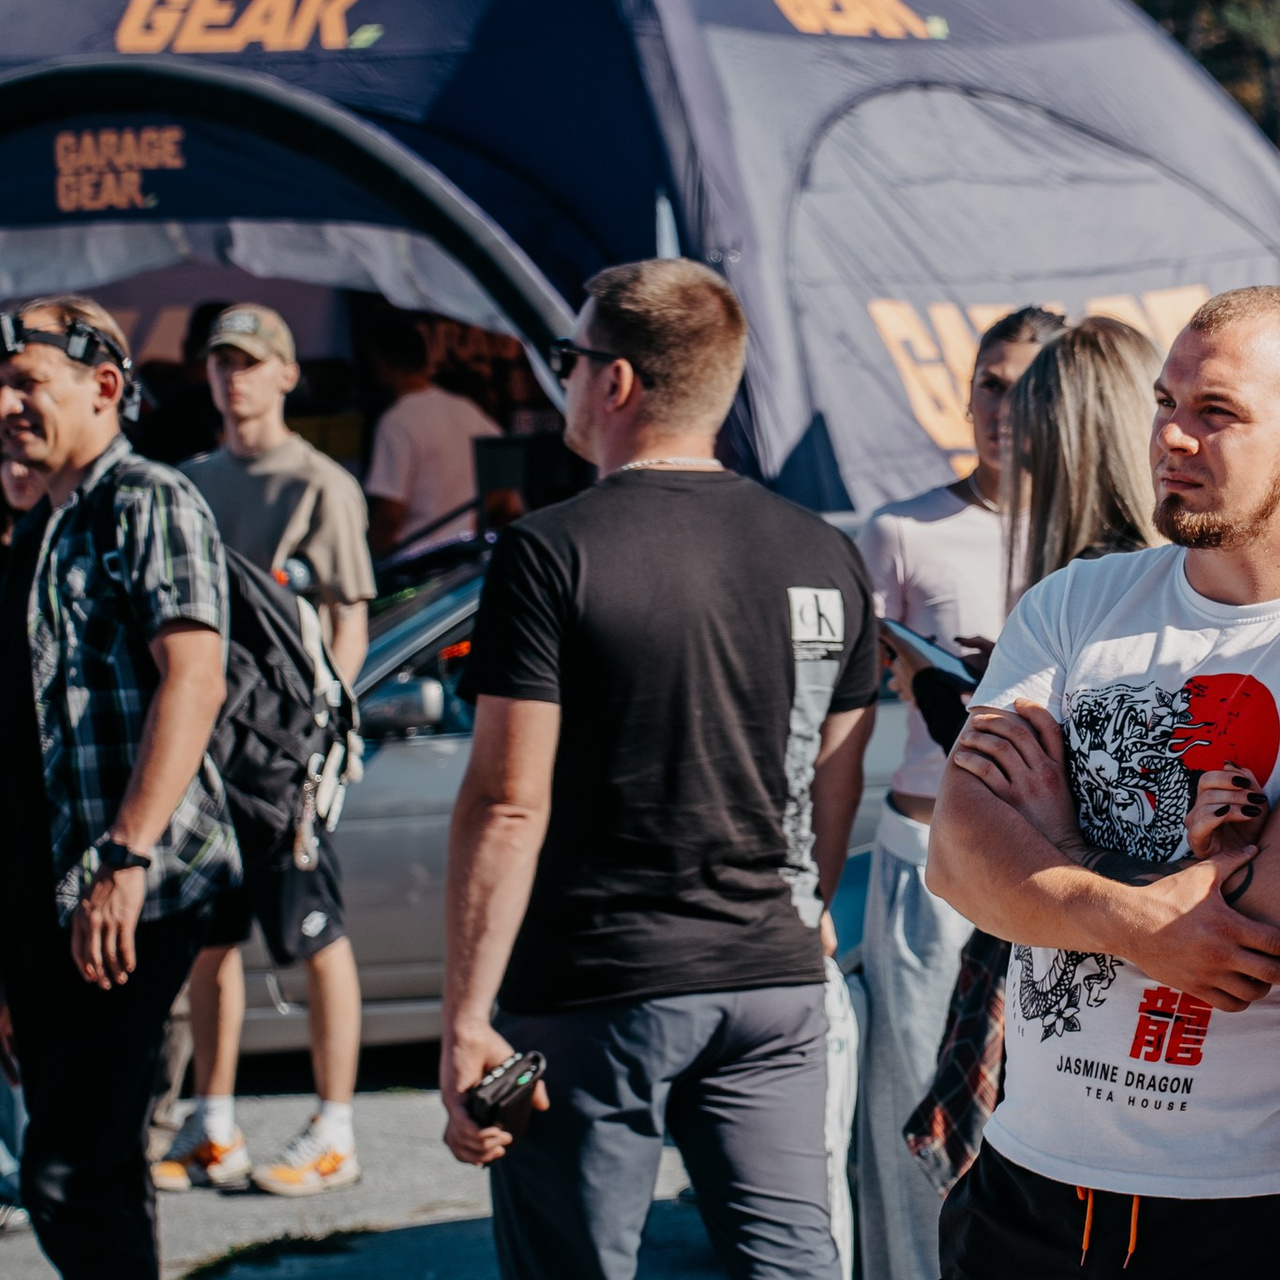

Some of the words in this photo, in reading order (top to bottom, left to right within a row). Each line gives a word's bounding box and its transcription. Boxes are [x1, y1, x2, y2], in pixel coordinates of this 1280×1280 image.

[55, 125, 185, 175] GARAGE
[1057, 1055, 1119, 1084] JASMINE
[1124, 1070, 1194, 1095] DRAGON
[1086, 1086, 1114, 1102] TEA
[1128, 1096, 1188, 1112] HOUSE
